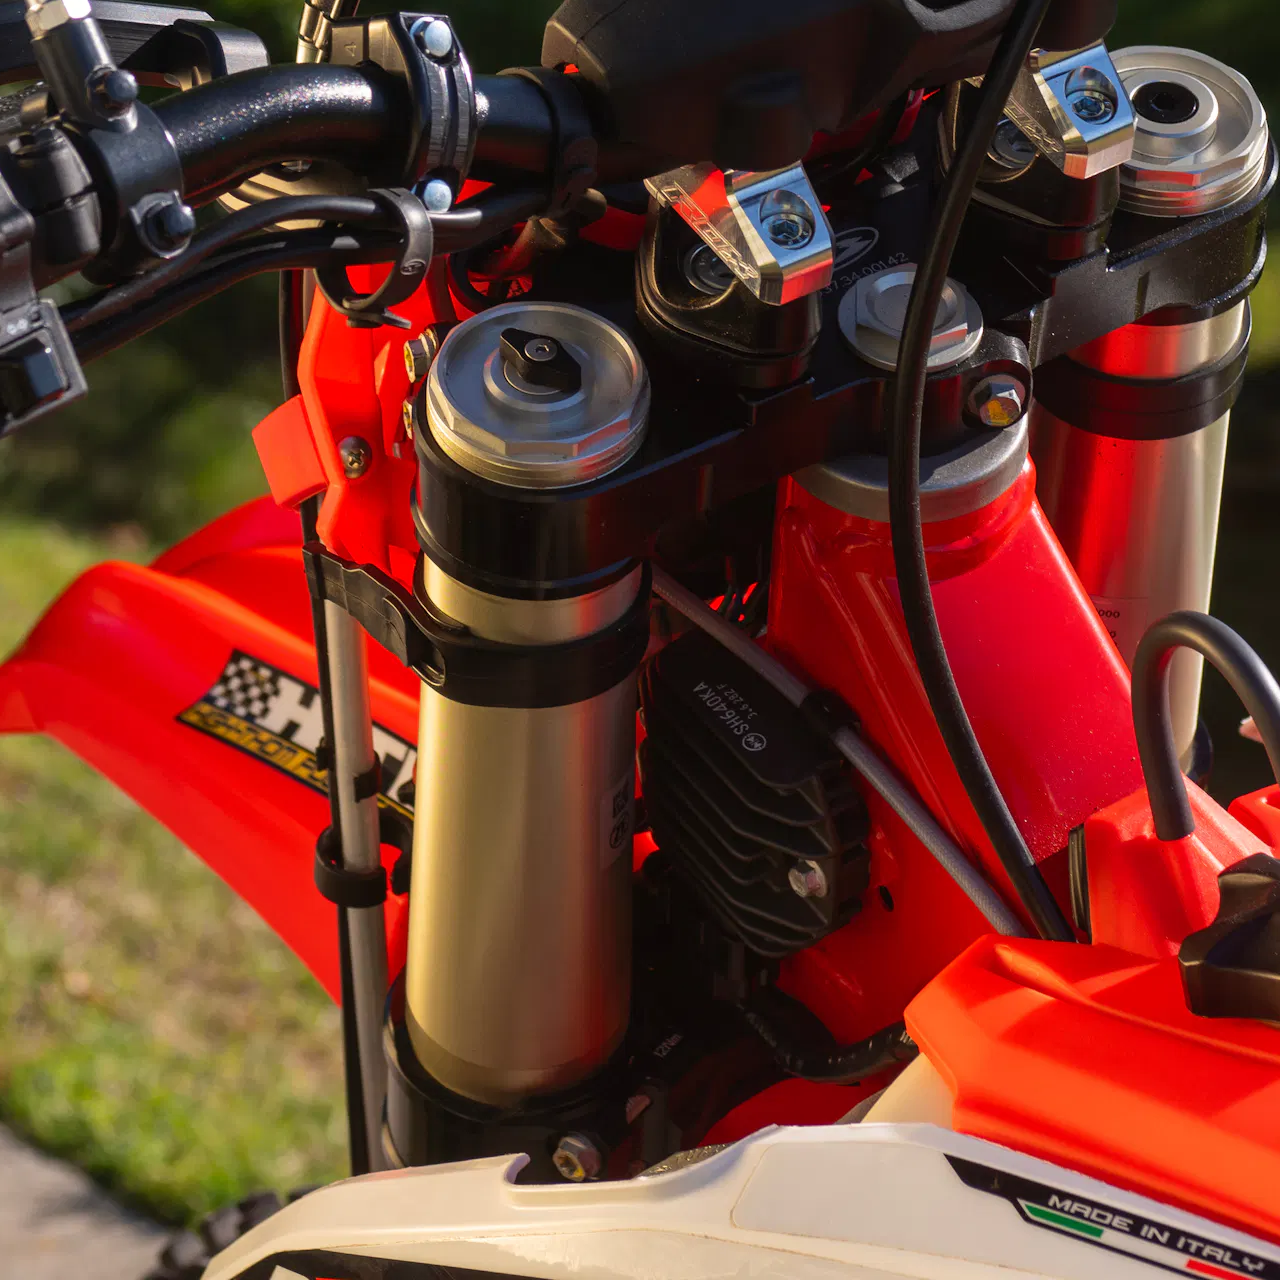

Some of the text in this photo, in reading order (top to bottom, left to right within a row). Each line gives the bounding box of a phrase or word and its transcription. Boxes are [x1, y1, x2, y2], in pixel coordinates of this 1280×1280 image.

[692, 680, 750, 735] SH640KA
[1047, 1194, 1267, 1272] MADE IN ITALY
